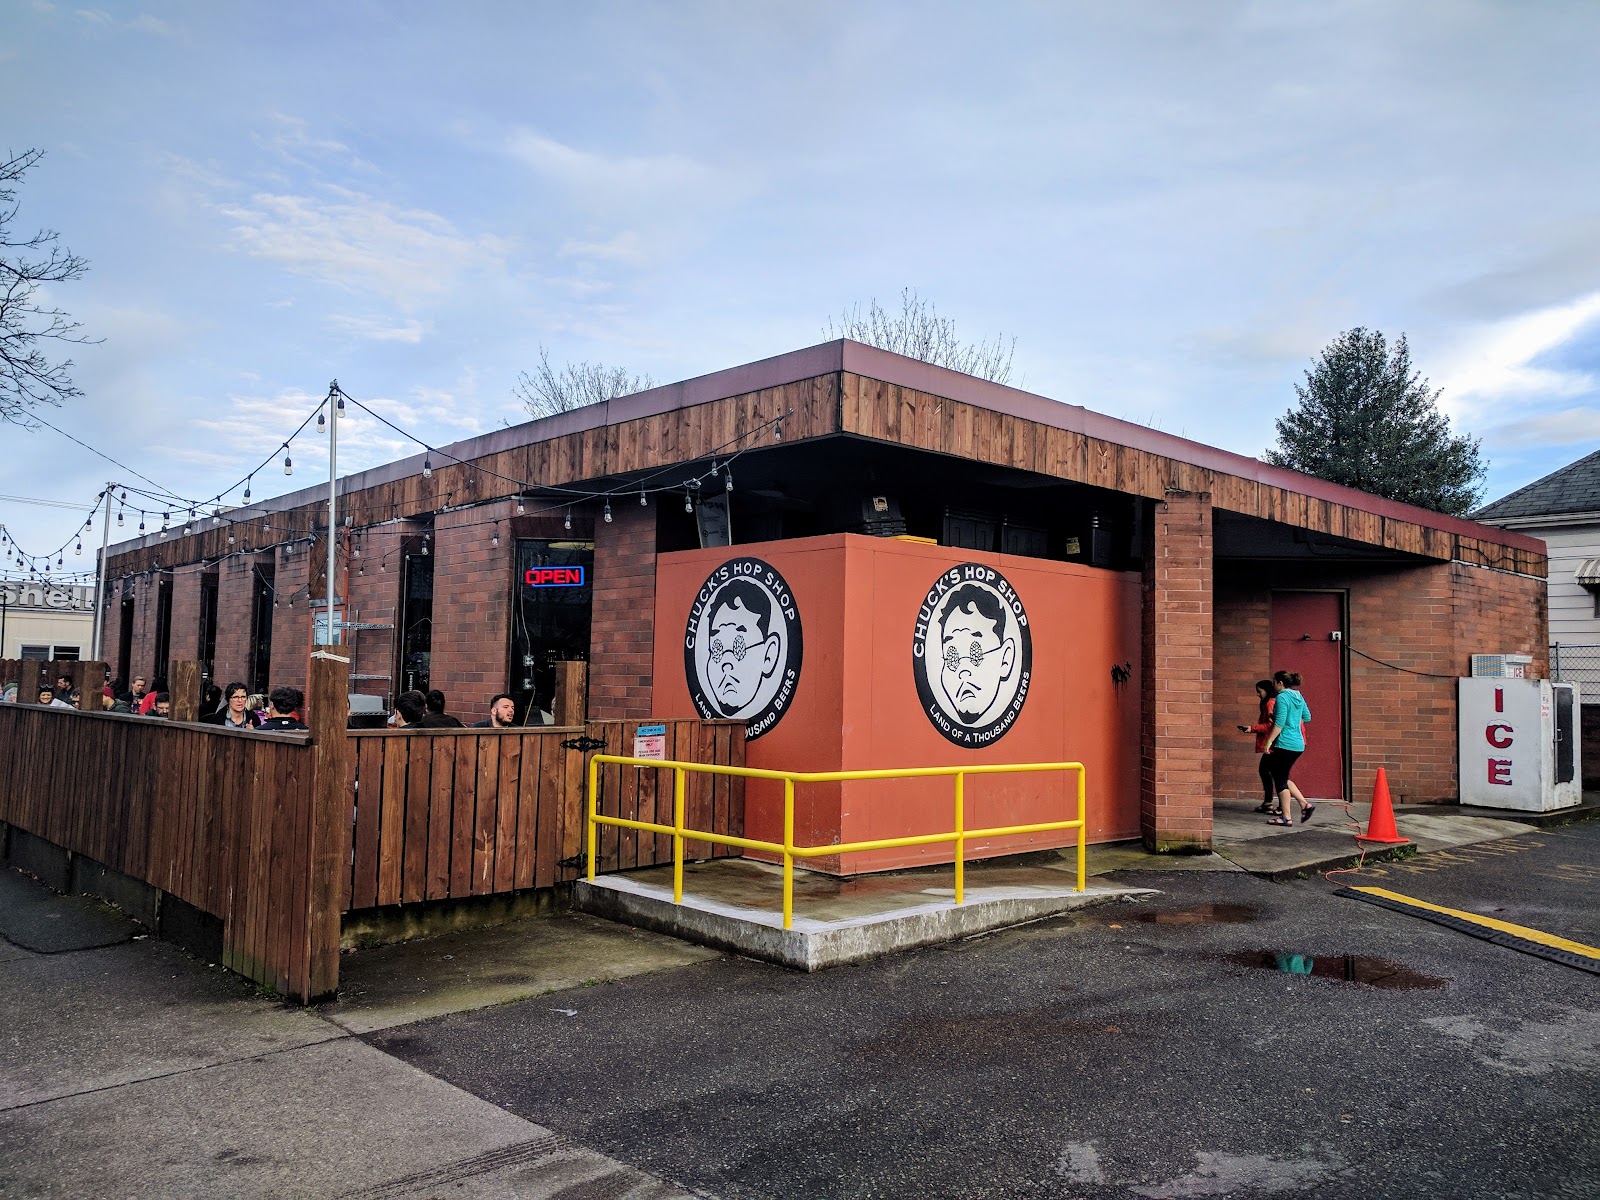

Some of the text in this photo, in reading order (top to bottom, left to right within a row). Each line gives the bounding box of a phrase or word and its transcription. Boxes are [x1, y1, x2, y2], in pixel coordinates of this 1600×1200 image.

[525, 569, 580, 584] OPEN
[686, 562, 795, 649] CHUCK'S HOP SHOP
[914, 566, 1028, 658] CHUCK'S HOP SHOP
[695, 668, 795, 739] LAND USAND BEERS
[930, 671, 1030, 743] LAND OF A THOUSAND BEERS
